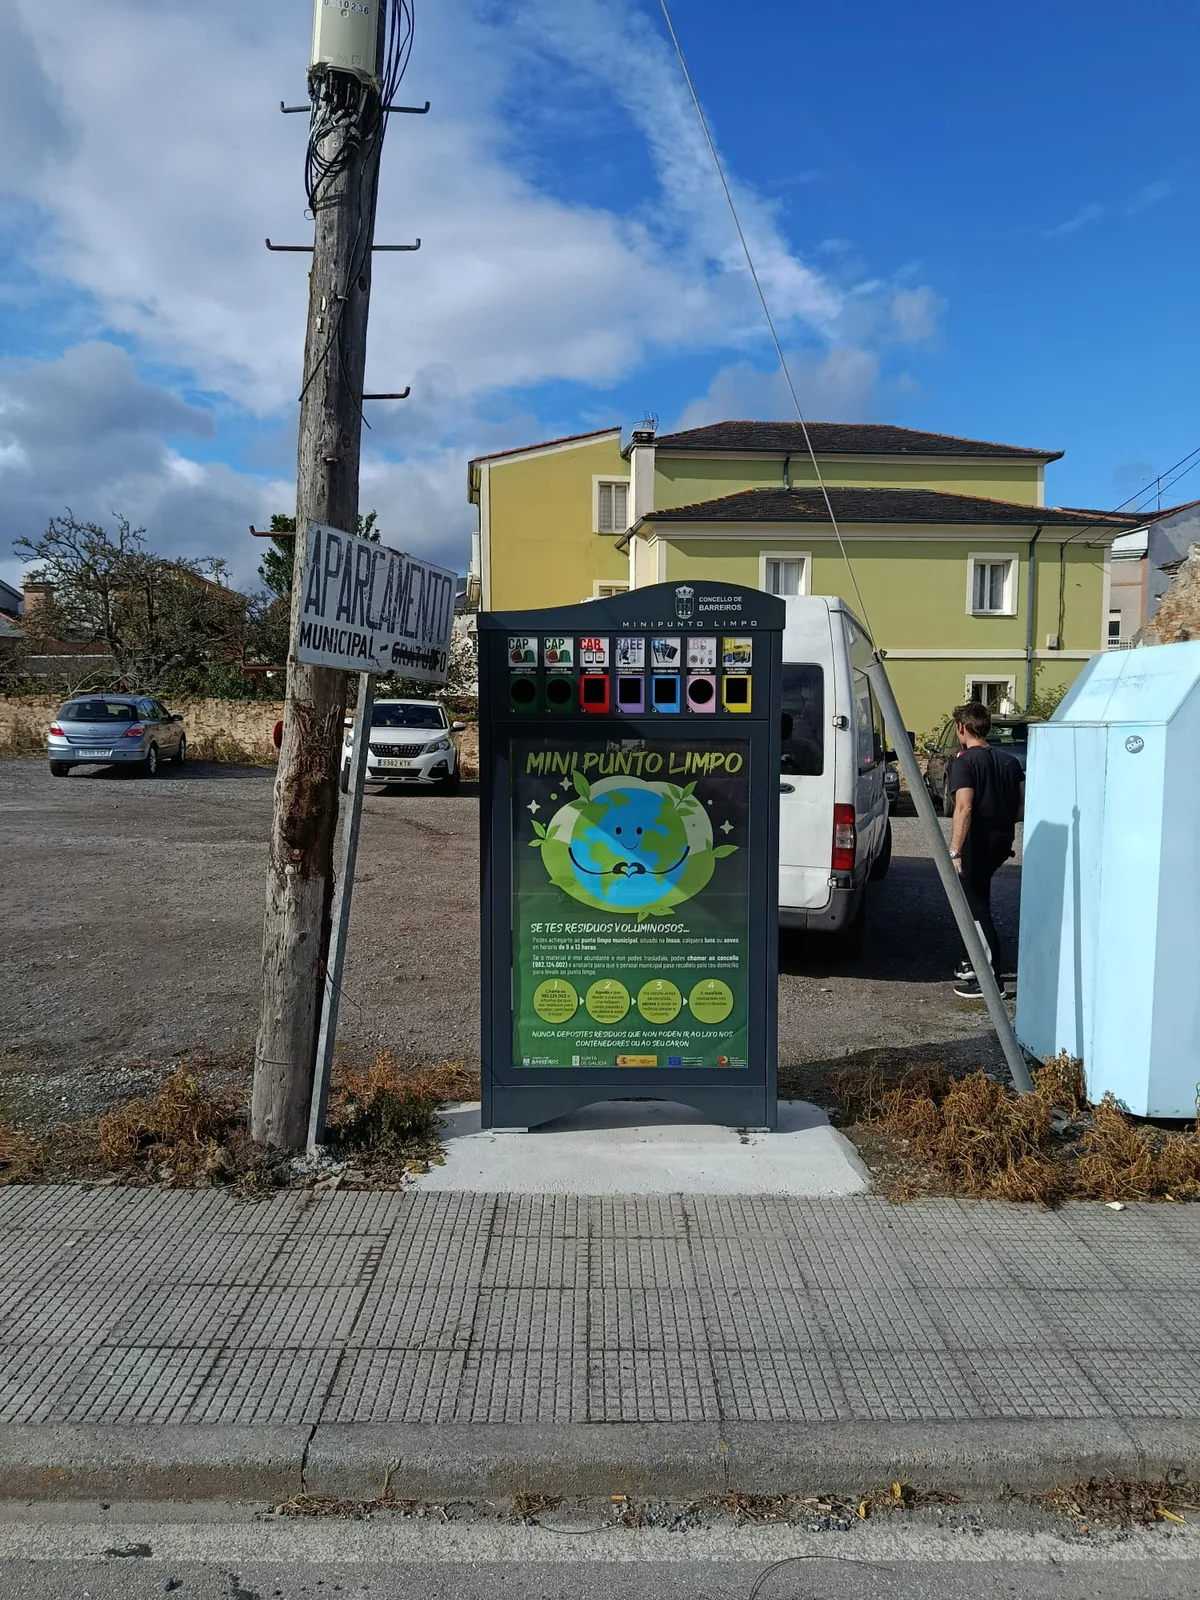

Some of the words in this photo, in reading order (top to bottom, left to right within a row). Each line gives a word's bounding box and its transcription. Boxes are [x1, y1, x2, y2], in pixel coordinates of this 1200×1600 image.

[299, 622, 376, 660] MUNICIPAL
[508, 638, 529, 650] CAP
[544, 638, 564, 650] CAP
[526, 752, 578, 776] MINI
[582, 752, 664, 776] PUNTO
[669, 752, 744, 777] LIMPO
[530, 923, 542, 933] SE
[545, 923, 563, 933] TES
[565, 923, 613, 934] RESIDUOS
[554, 980, 558, 989] 1
[604, 981, 611, 989] 2
[656, 981, 662, 990] 3
[708, 981, 714, 989] 4
